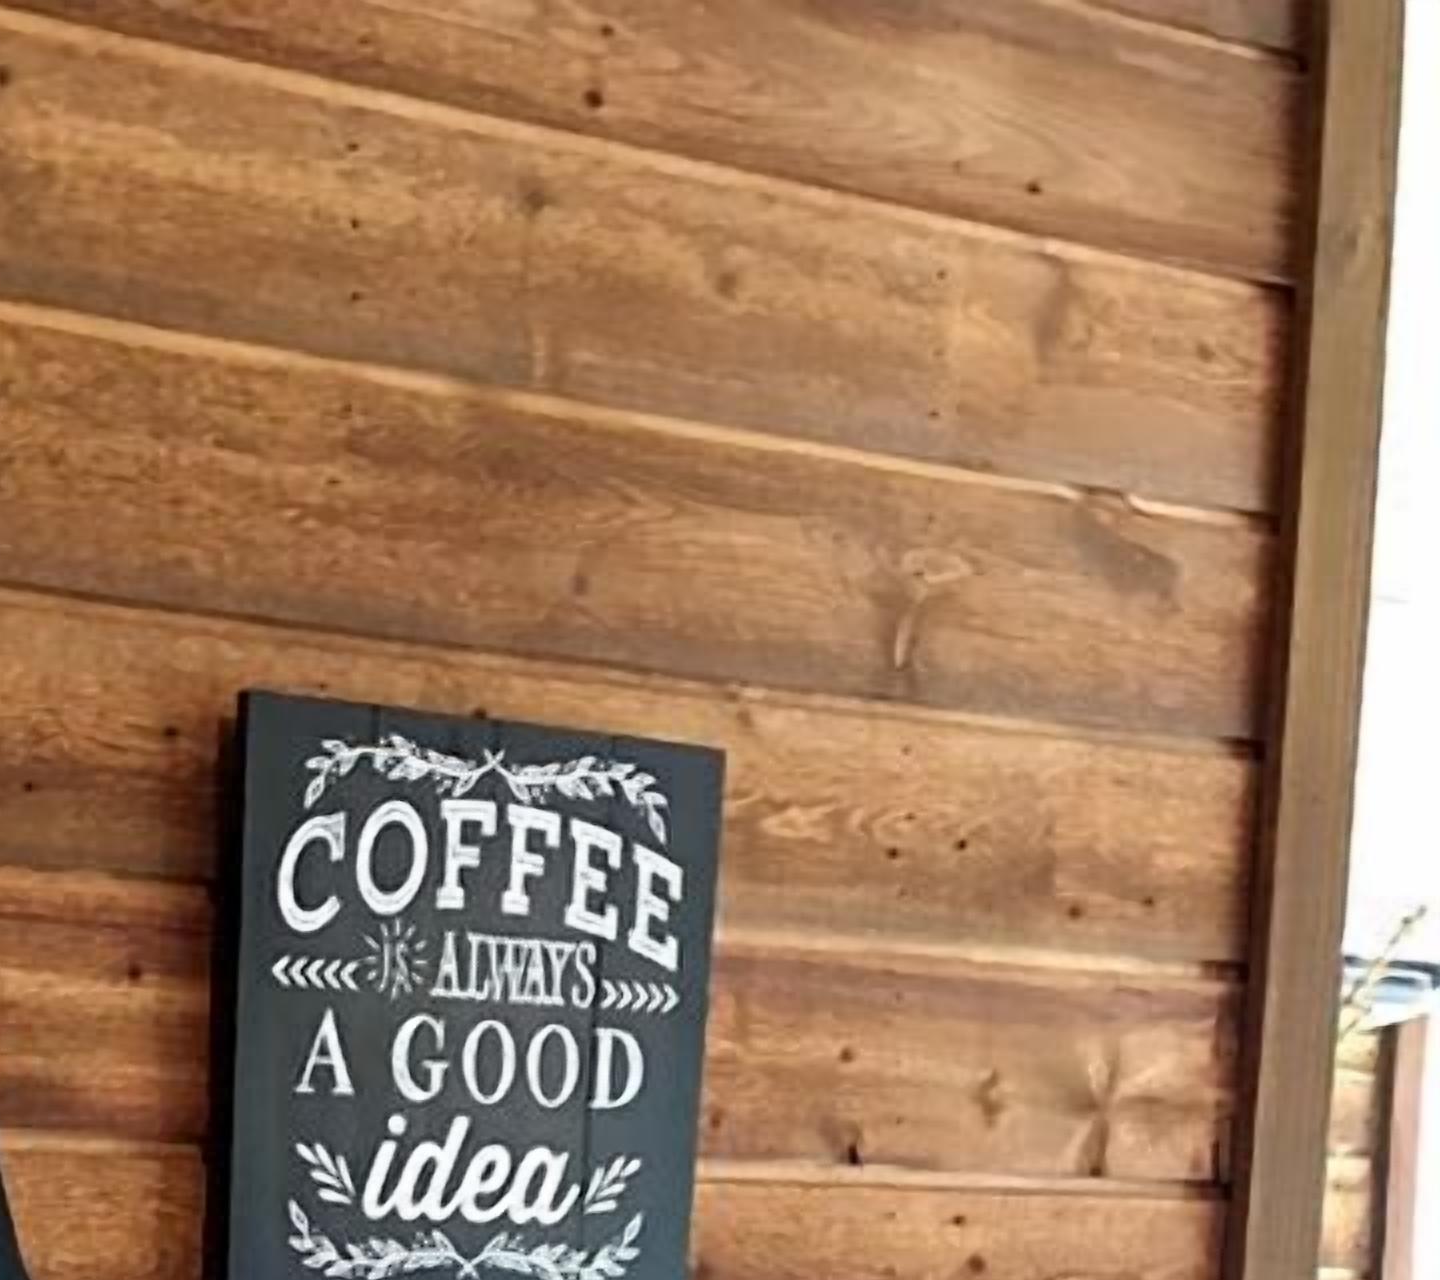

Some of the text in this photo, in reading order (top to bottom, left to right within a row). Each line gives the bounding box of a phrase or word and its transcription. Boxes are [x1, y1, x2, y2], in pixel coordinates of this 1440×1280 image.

[276, 799, 684, 972] COFFEE
[429, 930, 597, 1009] ALWAYS
[294, 1008, 645, 1110] A GOOD
[361, 1114, 582, 1225] idea
